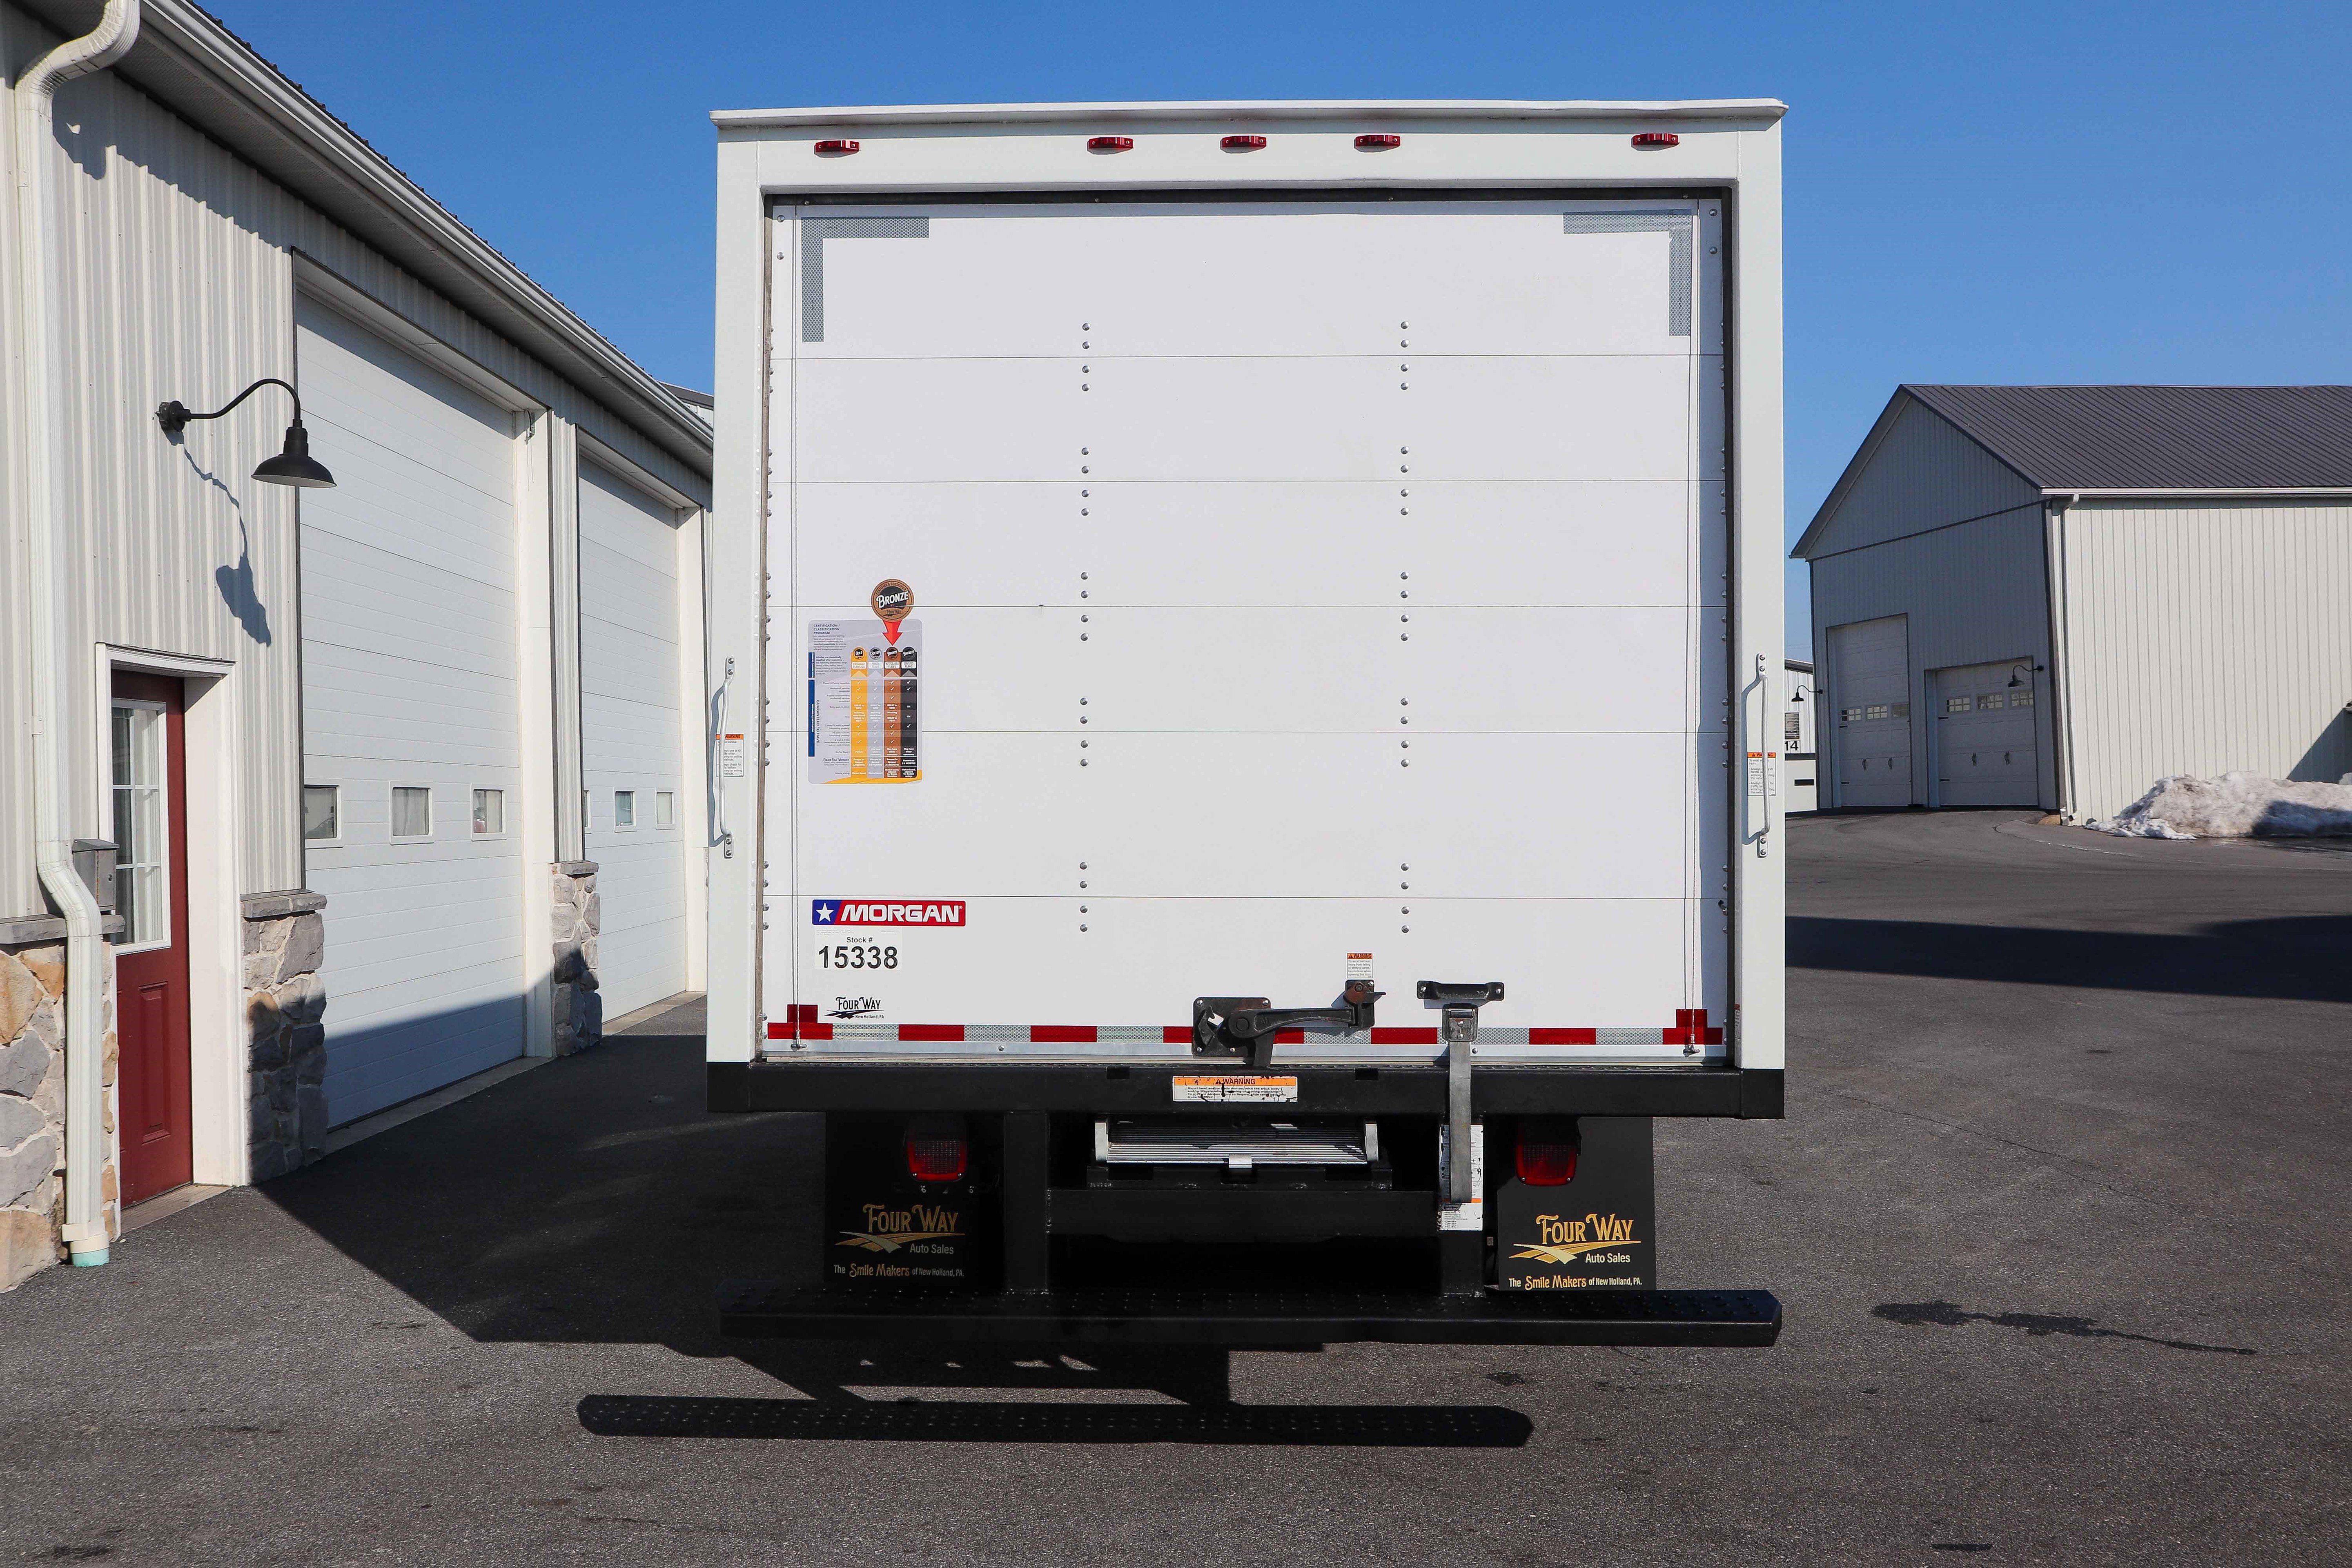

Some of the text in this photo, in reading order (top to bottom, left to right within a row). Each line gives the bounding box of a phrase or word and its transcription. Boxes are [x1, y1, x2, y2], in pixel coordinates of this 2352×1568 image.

[876, 591, 909, 608] BRONZE
[840, 904, 959, 922] MORGAN
[819, 946, 898, 969] 15338
[835, 996, 881, 1010] FOUR WAY
[862, 1204, 958, 1233] FOUR WAY
[1536, 1214, 1634, 1245] FOUR WAY
[910, 1243, 954, 1254] Auto Sales
[1585, 1252, 1630, 1263] Auto Sales
[834, 1265, 845, 1274] The
[849, 1263, 873, 1277] Smile
[875, 1264, 910, 1277] Makers
[932, 1268, 955, 1278] Holland,
[1509, 1275, 1642, 1290] The Smile Makers of New Holland, PA.
